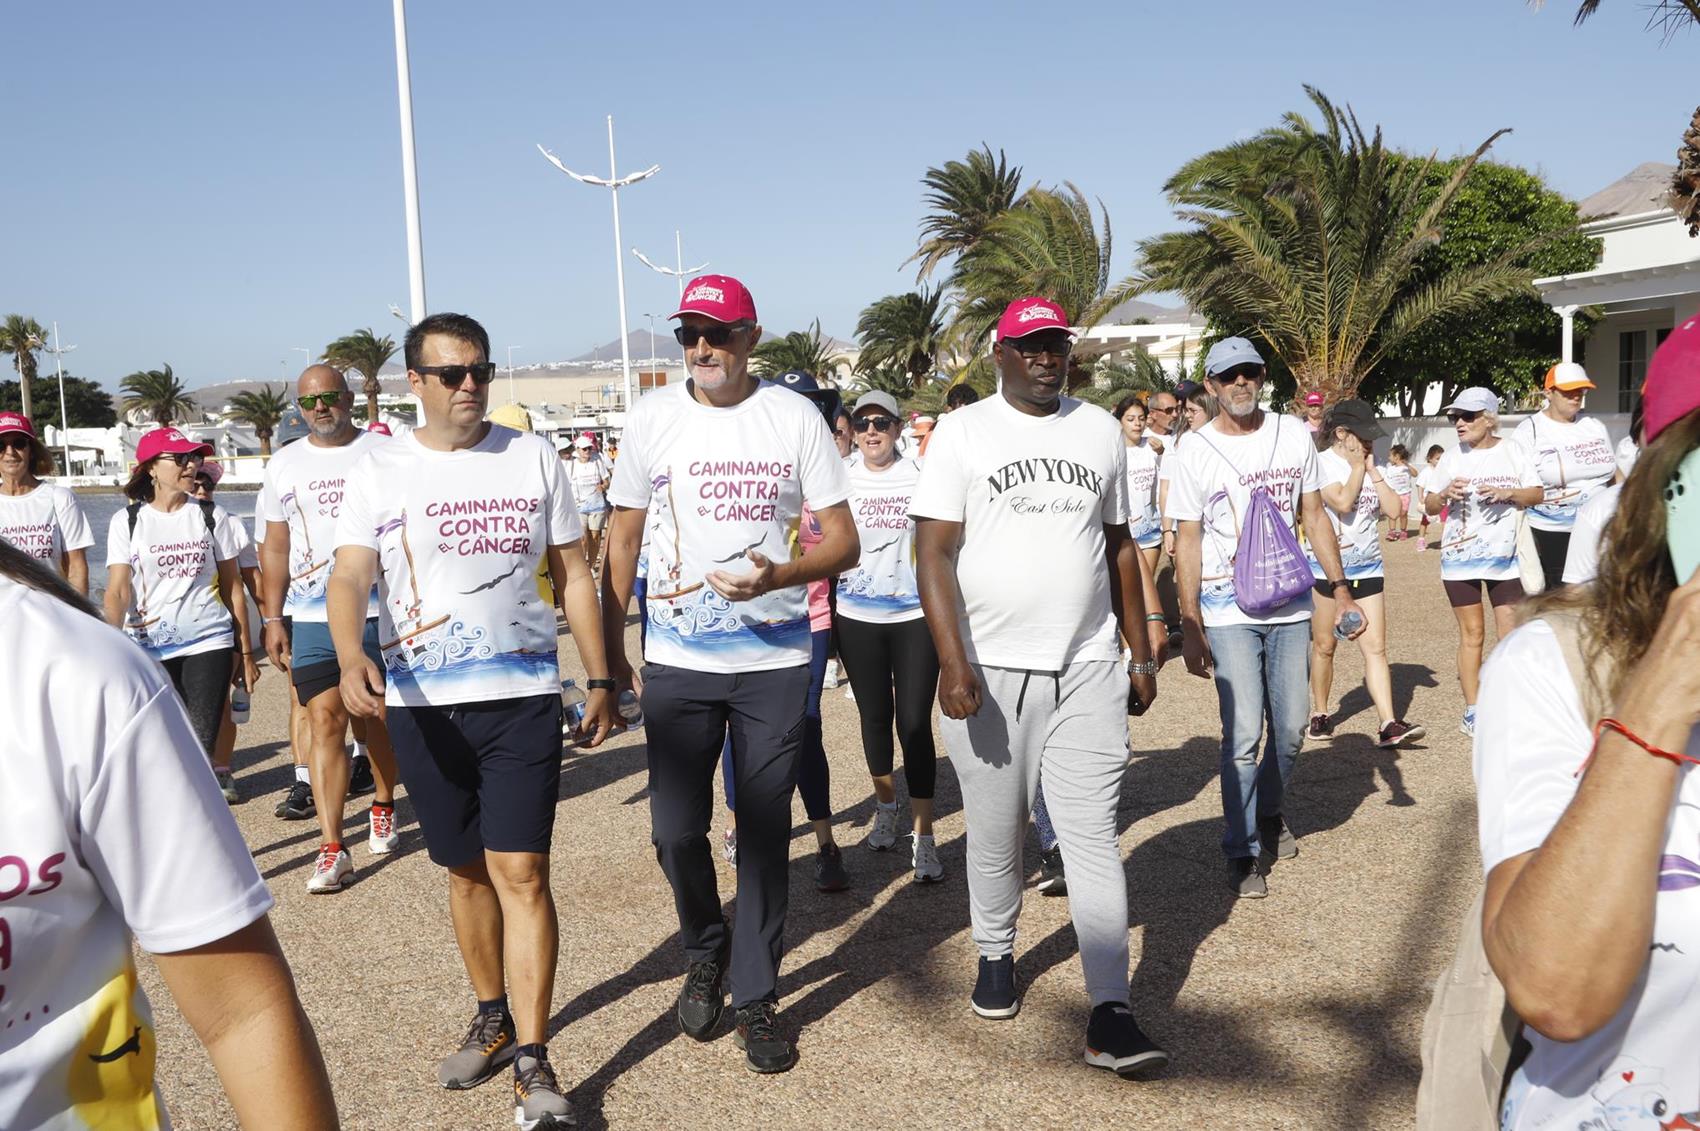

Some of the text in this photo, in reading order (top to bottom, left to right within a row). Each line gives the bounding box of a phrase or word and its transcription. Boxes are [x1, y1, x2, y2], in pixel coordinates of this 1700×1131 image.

[689, 461, 792, 478] CAMINAMOS
[1239, 467, 1302, 486] CAMINAMOS
[987, 458, 1103, 504] NEW YORK
[699, 480, 779, 500] CONTRA
[425, 497, 539, 518] CAMINAMOS
[697, 505, 711, 517] EL
[1010, 496, 1086, 514] East Side
[438, 516, 530, 538] CONTRA
[10, 534, 53, 547] ONTRA
[150, 540, 210, 554] CAMINAMOS
[438, 541, 454, 553] EL
[157, 552, 206, 567] CONTRA
